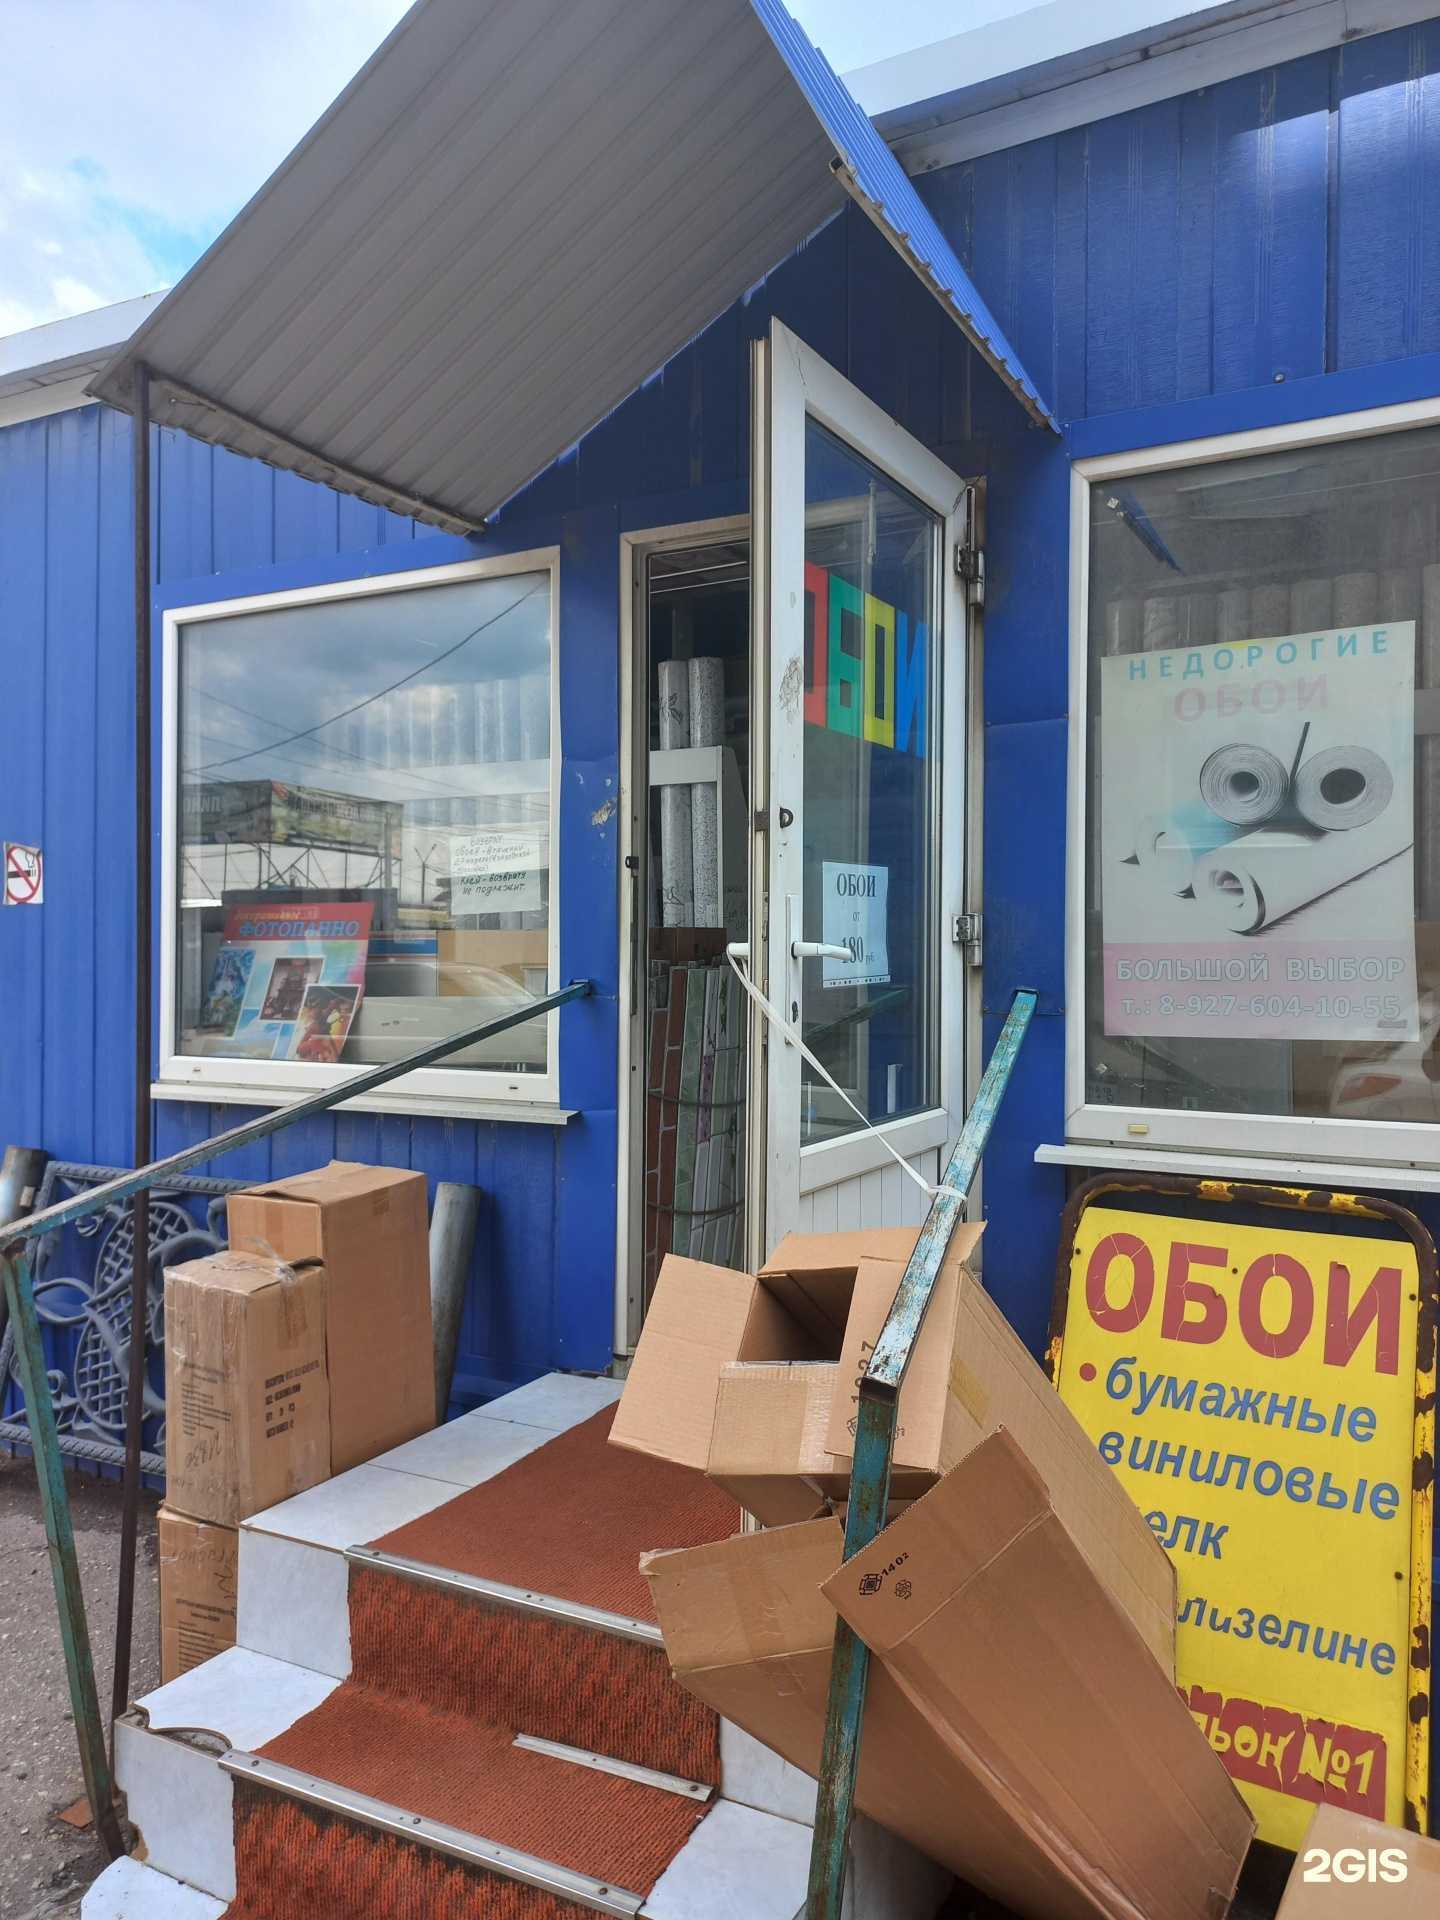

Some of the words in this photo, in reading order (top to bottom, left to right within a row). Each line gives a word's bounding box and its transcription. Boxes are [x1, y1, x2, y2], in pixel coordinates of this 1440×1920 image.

[1128, 630, 1388, 681] НЕДОРОГИЕ
[1174, 674, 1329, 722] ОБОИ
[837, 872, 877, 898] ОБОИ
[1115, 952, 1271, 983] БОЛЬШОЙ
[1286, 958, 1405, 983] ВЫБОР
[1158, 994, 1402, 1020] 8-927-604-10-55
[1086, 1232, 1403, 1377] ОБОИ
[1105, 1356, 1377, 1443] бумажные
[1098, 1431, 1401, 1521] виниловые
[1143, 1510, 1230, 1560] елк
[1177, 1596, 1397, 1676] лизелине
